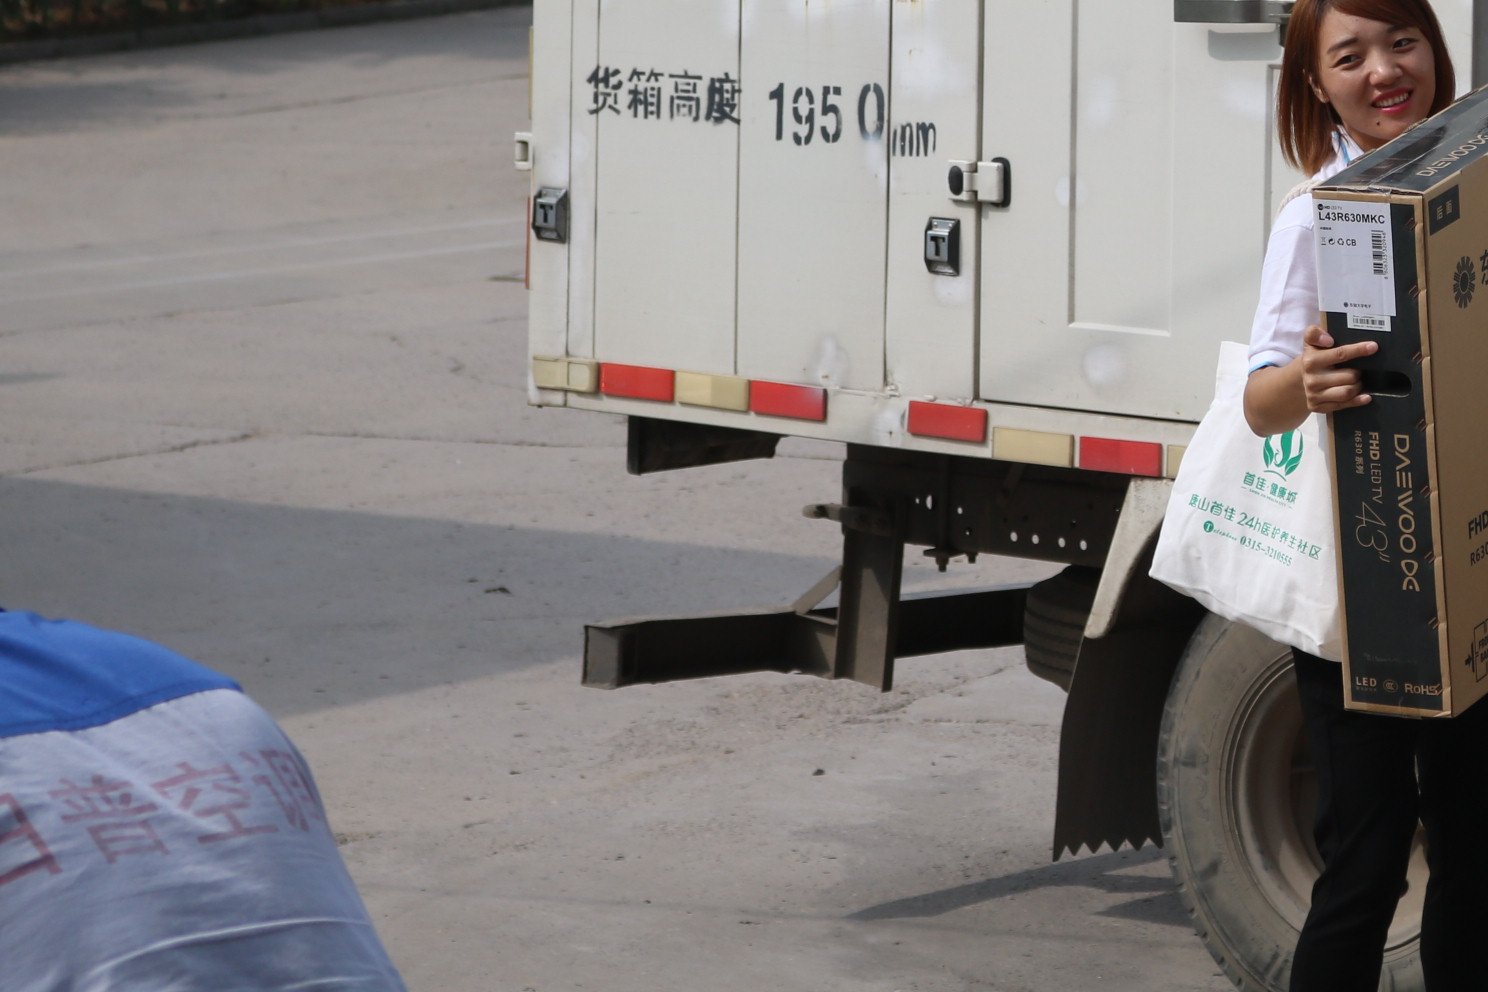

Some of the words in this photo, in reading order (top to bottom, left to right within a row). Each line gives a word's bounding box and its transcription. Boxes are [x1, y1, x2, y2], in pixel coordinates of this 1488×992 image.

[586, 64, 741, 126] 货箱高度
[1416, 143, 1478, 177] DAEWOO
[1318, 211, 1385, 224] L43R630MKC
[1345, 238, 1357, 247] CB
[1354, 430, 1363, 455] R630
[1369, 431, 1380, 461] FHD
[1355, 456, 1364, 475] 系列
[1370, 463, 1381, 484] LED
[1372, 486, 1383, 504] TV
[1394, 433, 1417, 554] DAEWOO
[1355, 676, 1377, 687] LED
[1404, 683, 1438, 696] RoHS
